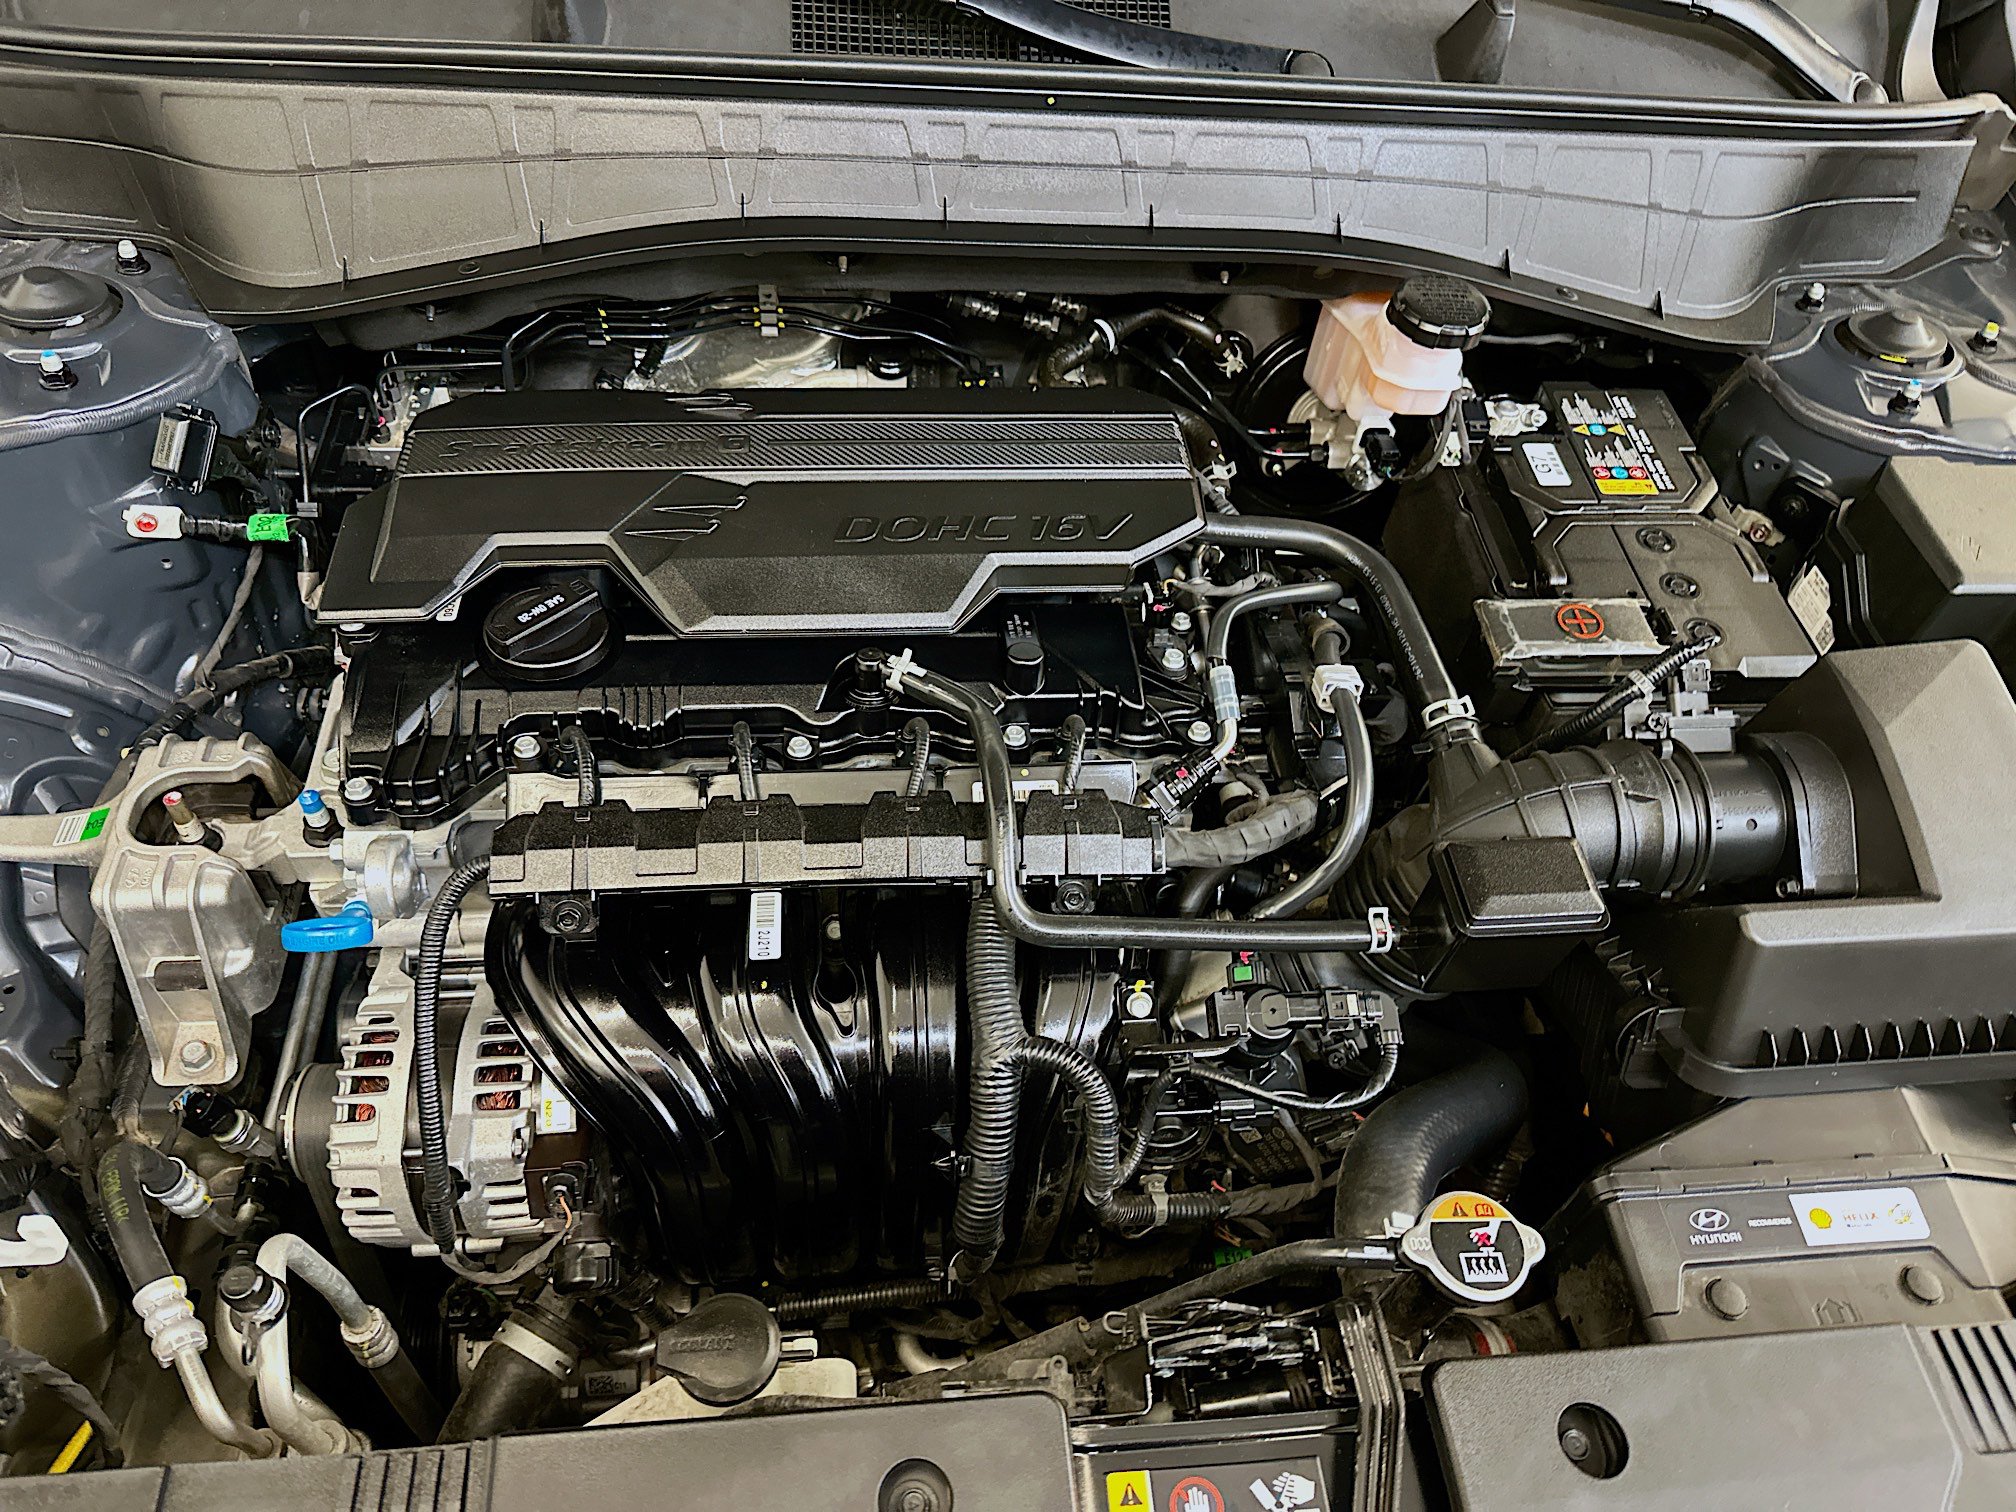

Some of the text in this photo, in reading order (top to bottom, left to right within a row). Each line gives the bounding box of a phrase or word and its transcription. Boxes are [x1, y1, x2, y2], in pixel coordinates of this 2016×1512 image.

[438, 436, 706, 458] Smartstream
[1530, 456, 1552, 474] G7
[834, 512, 1133, 543] DOHC 16V
[517, 594, 565, 623] SAE 0W-20
[757, 930, 771, 957] 2J210
[1689, 1216, 1793, 1246] HYUNDAI RECOMMENDS
